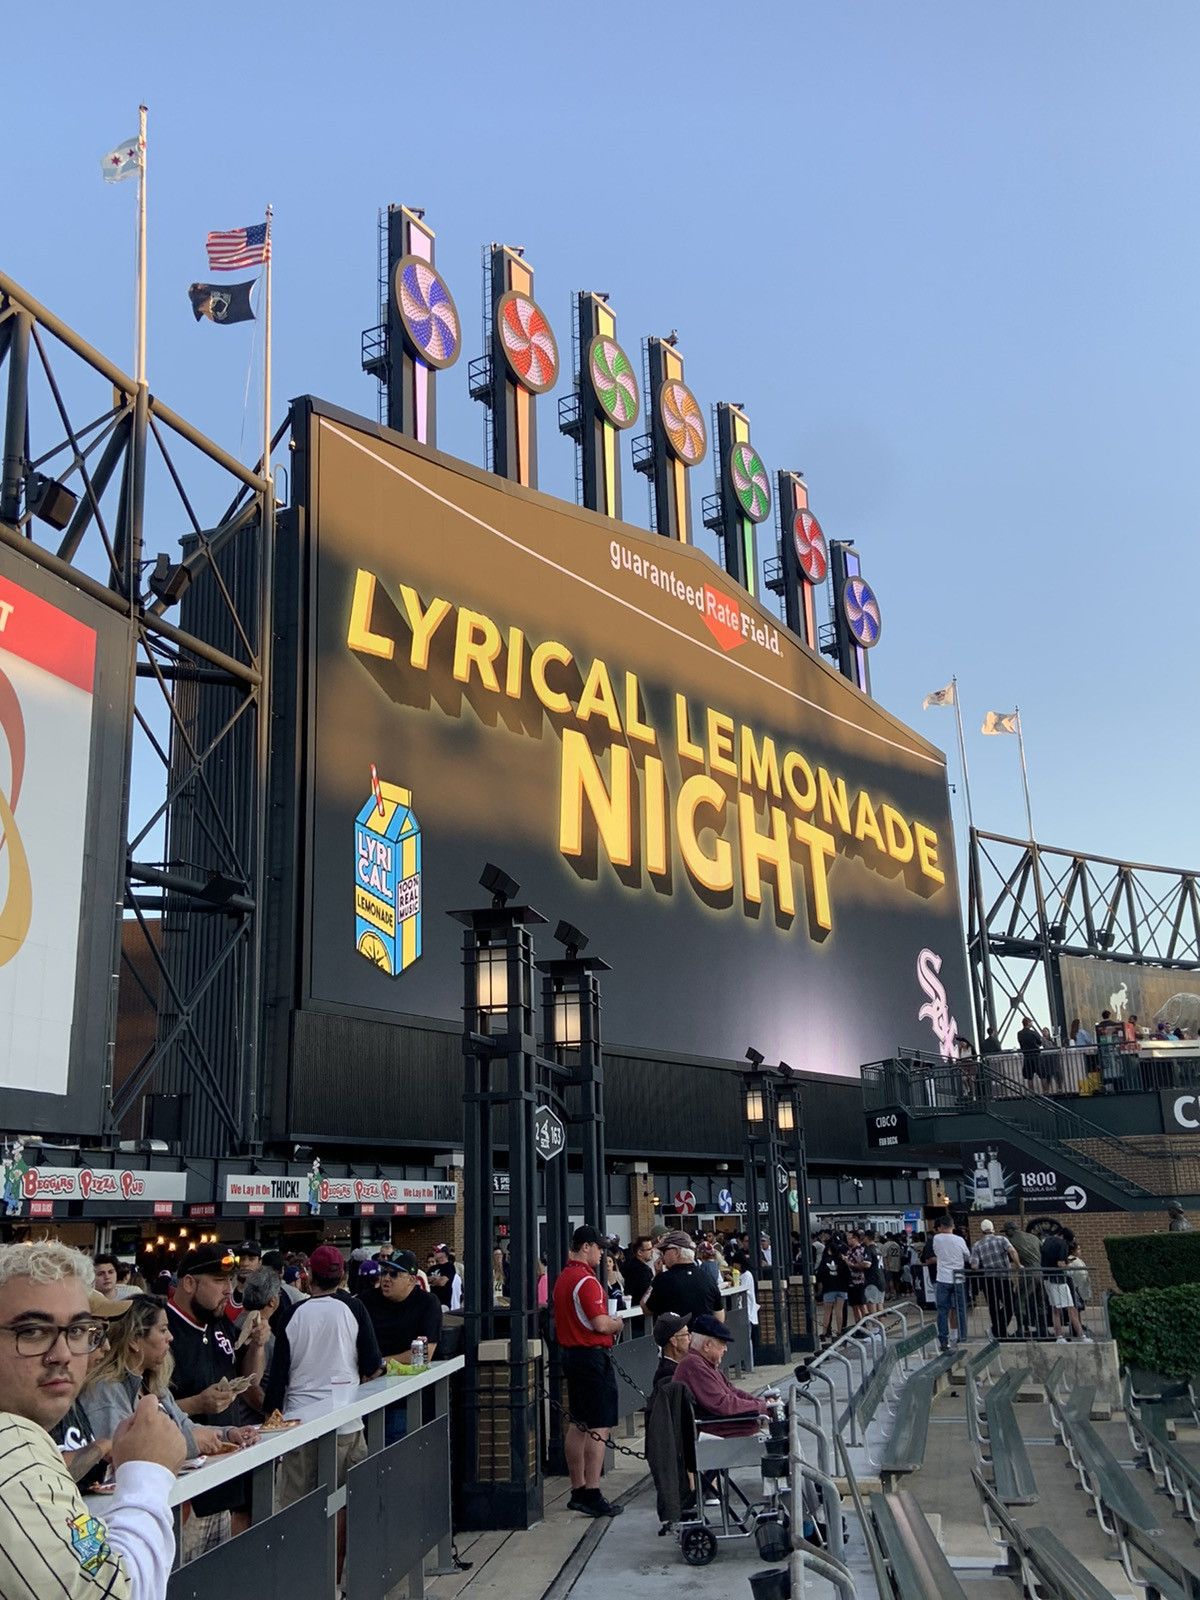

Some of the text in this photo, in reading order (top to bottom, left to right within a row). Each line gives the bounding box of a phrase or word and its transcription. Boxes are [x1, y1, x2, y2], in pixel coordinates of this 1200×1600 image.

[609, 540, 780, 655] guaranteed Rate Field
[347, 567, 945, 884] LYRICAL LEMONADE
[559, 727, 836, 932] NIGHT
[358, 858, 393, 899] CAL
[399, 876, 420, 895] 100%
[399, 888, 418, 907] REAL
[357, 894, 394, 928] LEMONADE
[399, 901, 418, 920] MUSIC
[1174, 1095, 1200, 1128] C
[875, 1115, 891, 1128] CIBC
[1020, 1171, 1057, 1187] 1800
[230, 1180, 300, 1198] We Lay It On THICK!
[404, 1188, 412, 1198] We
[413, 1188, 422, 1198] Lay
[422, 1188, 426, 1198] It
[426, 1188, 433, 1198] On
[434, 1185, 455, 1200] THICK!
